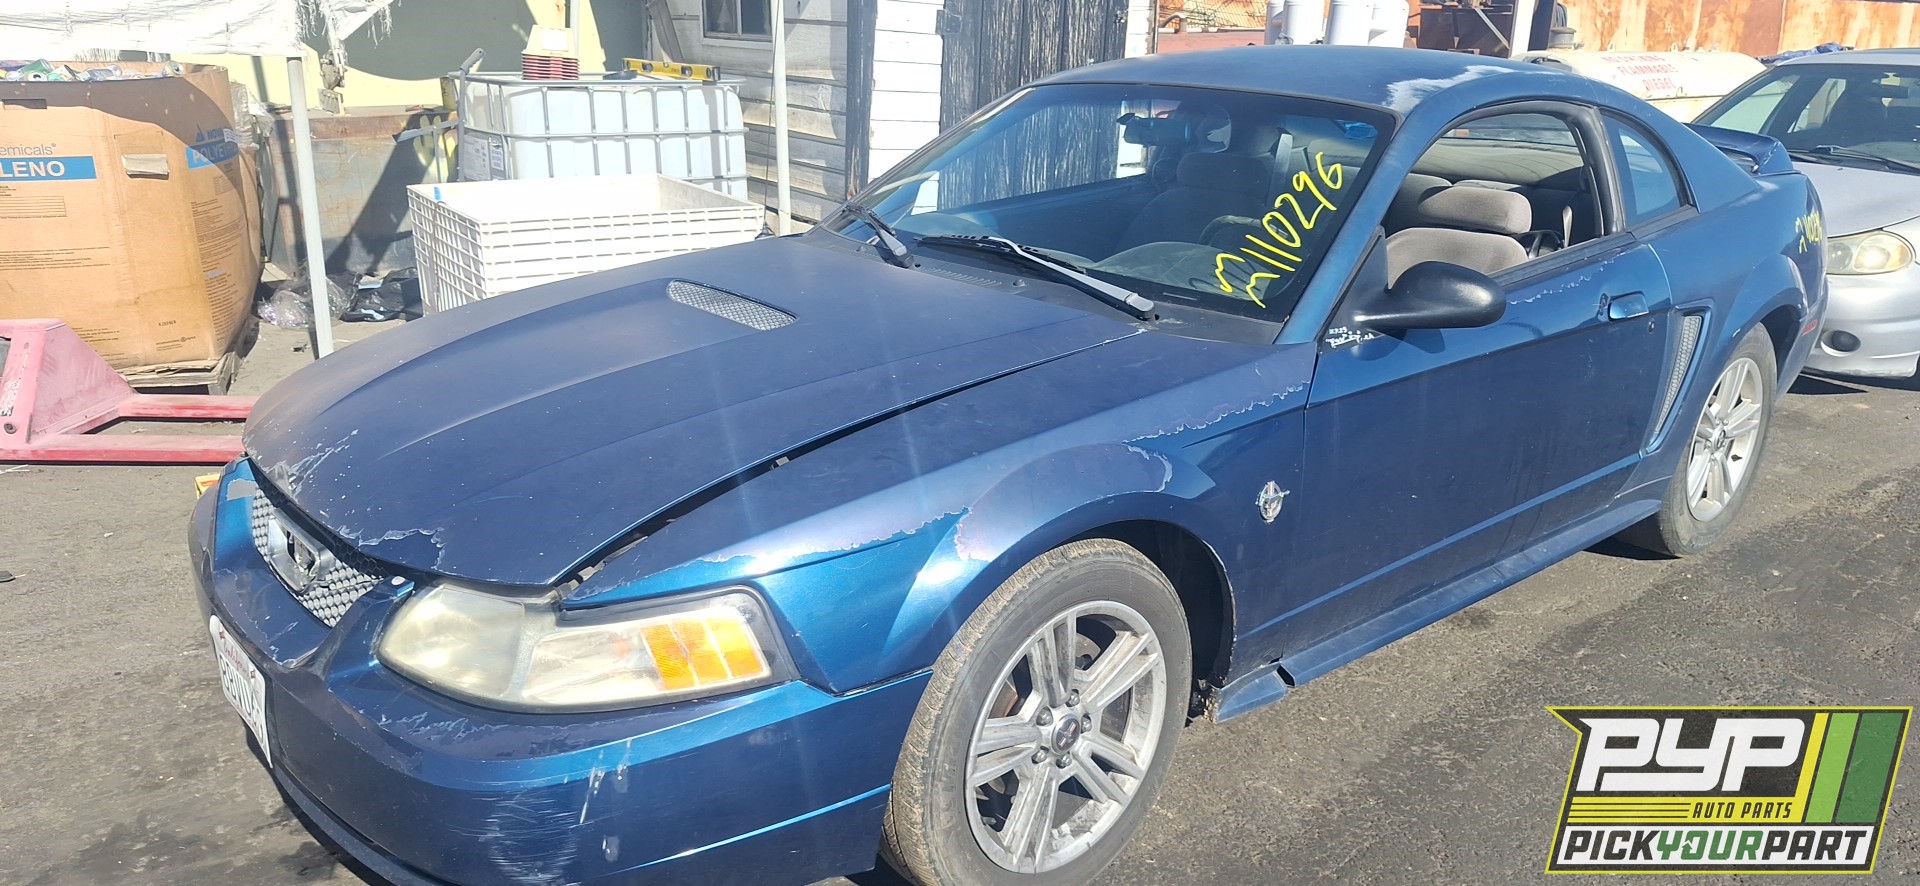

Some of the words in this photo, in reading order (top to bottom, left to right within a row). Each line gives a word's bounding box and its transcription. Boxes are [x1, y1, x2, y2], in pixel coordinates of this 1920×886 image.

[1617, 64, 1679, 76] FLAMMABLE
[1643, 78, 1677, 91] DIESEL
[0, 160, 66, 178] LENO
